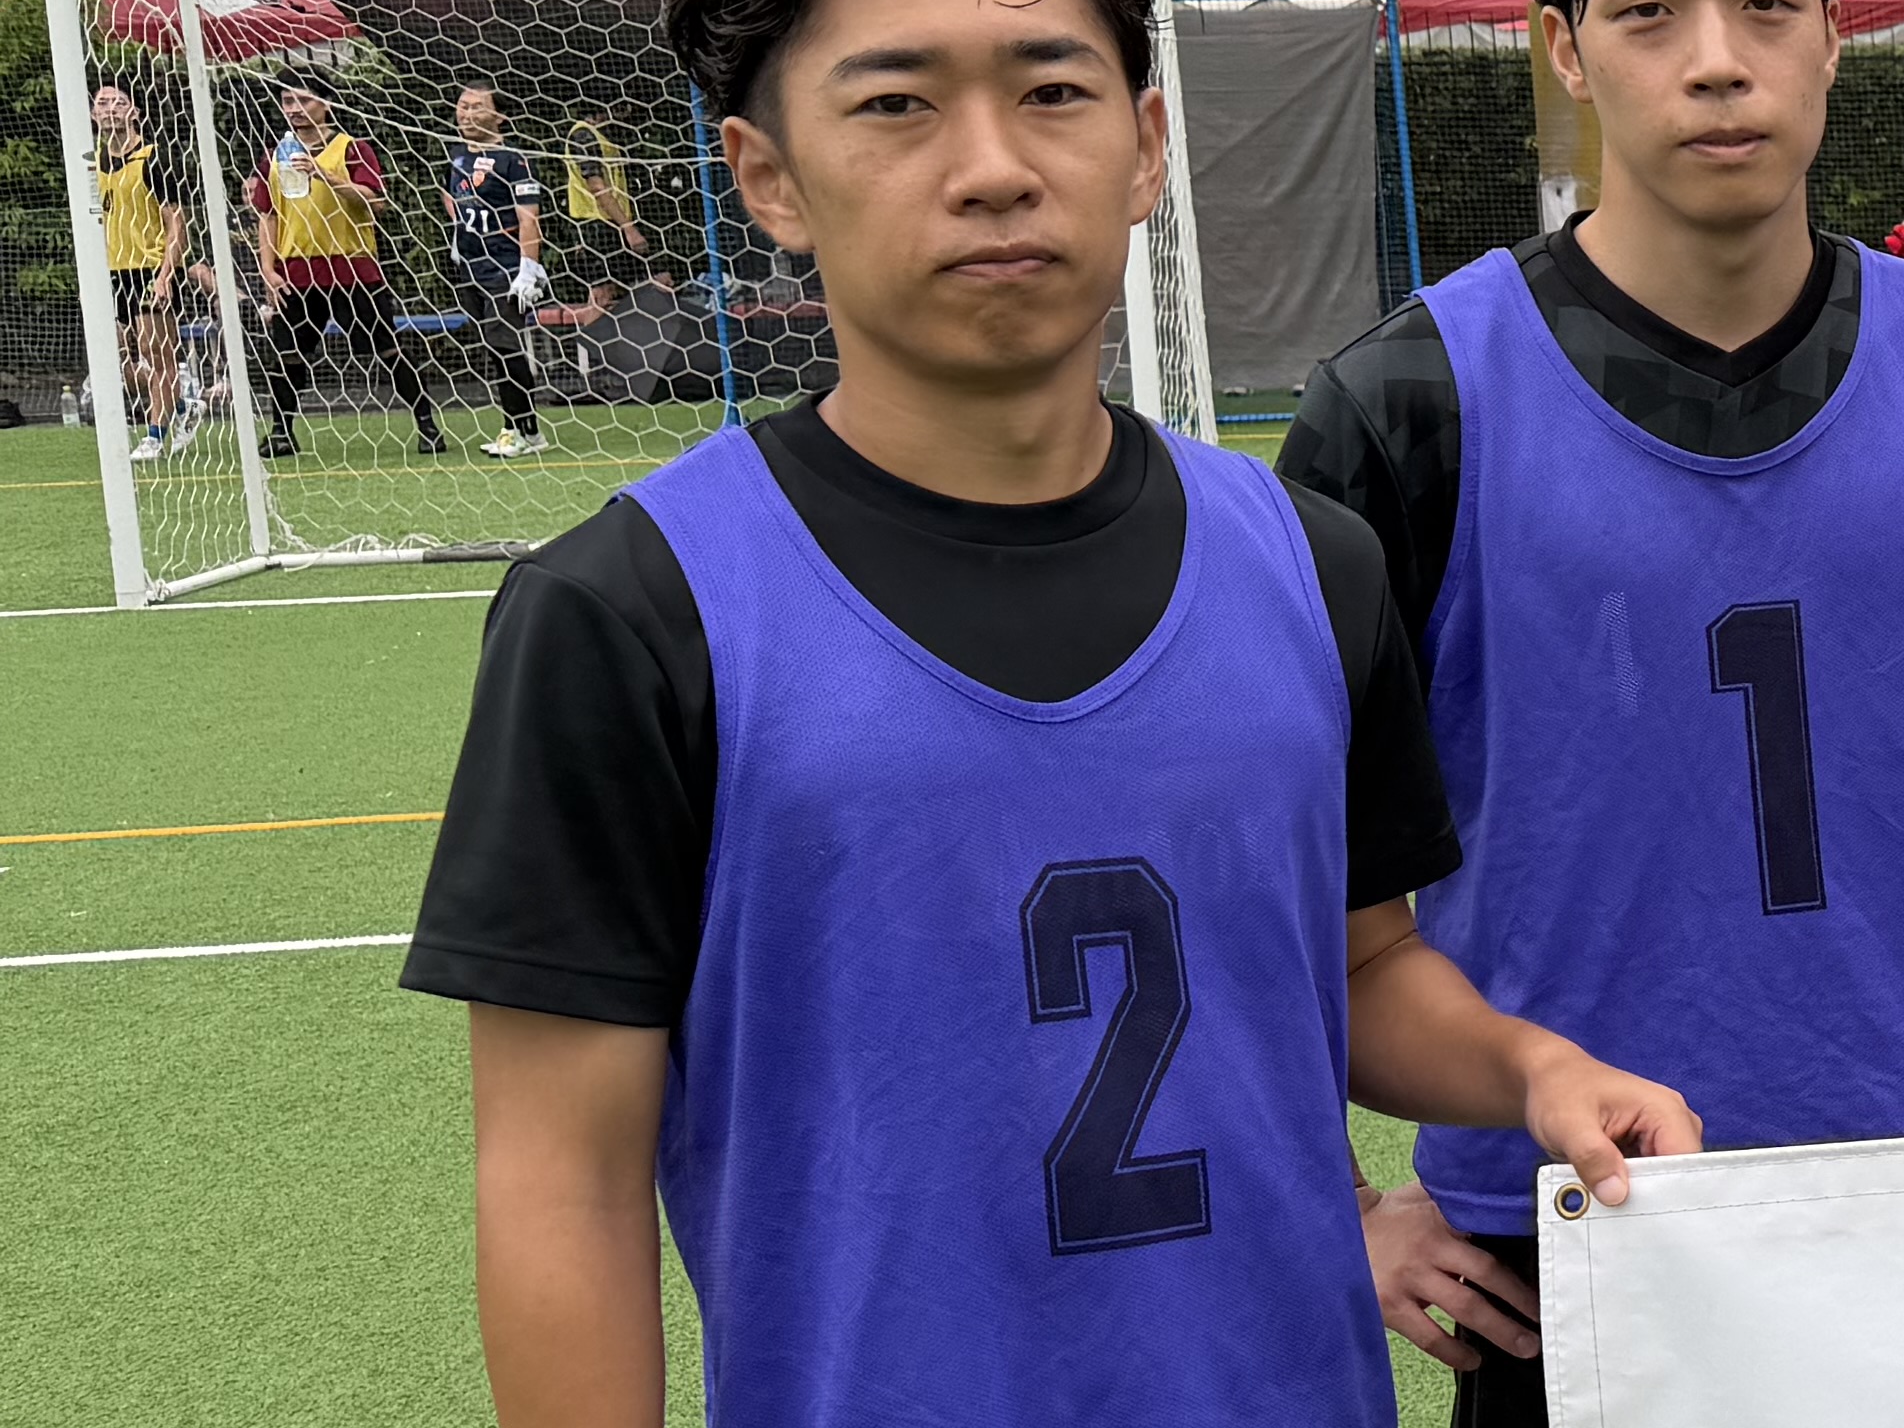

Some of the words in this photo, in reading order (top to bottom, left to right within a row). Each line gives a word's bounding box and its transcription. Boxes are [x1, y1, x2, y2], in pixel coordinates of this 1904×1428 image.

[465, 208, 489, 234] 21
[1705, 599, 1827, 916] 1
[1018, 856, 1212, 1258] 2
